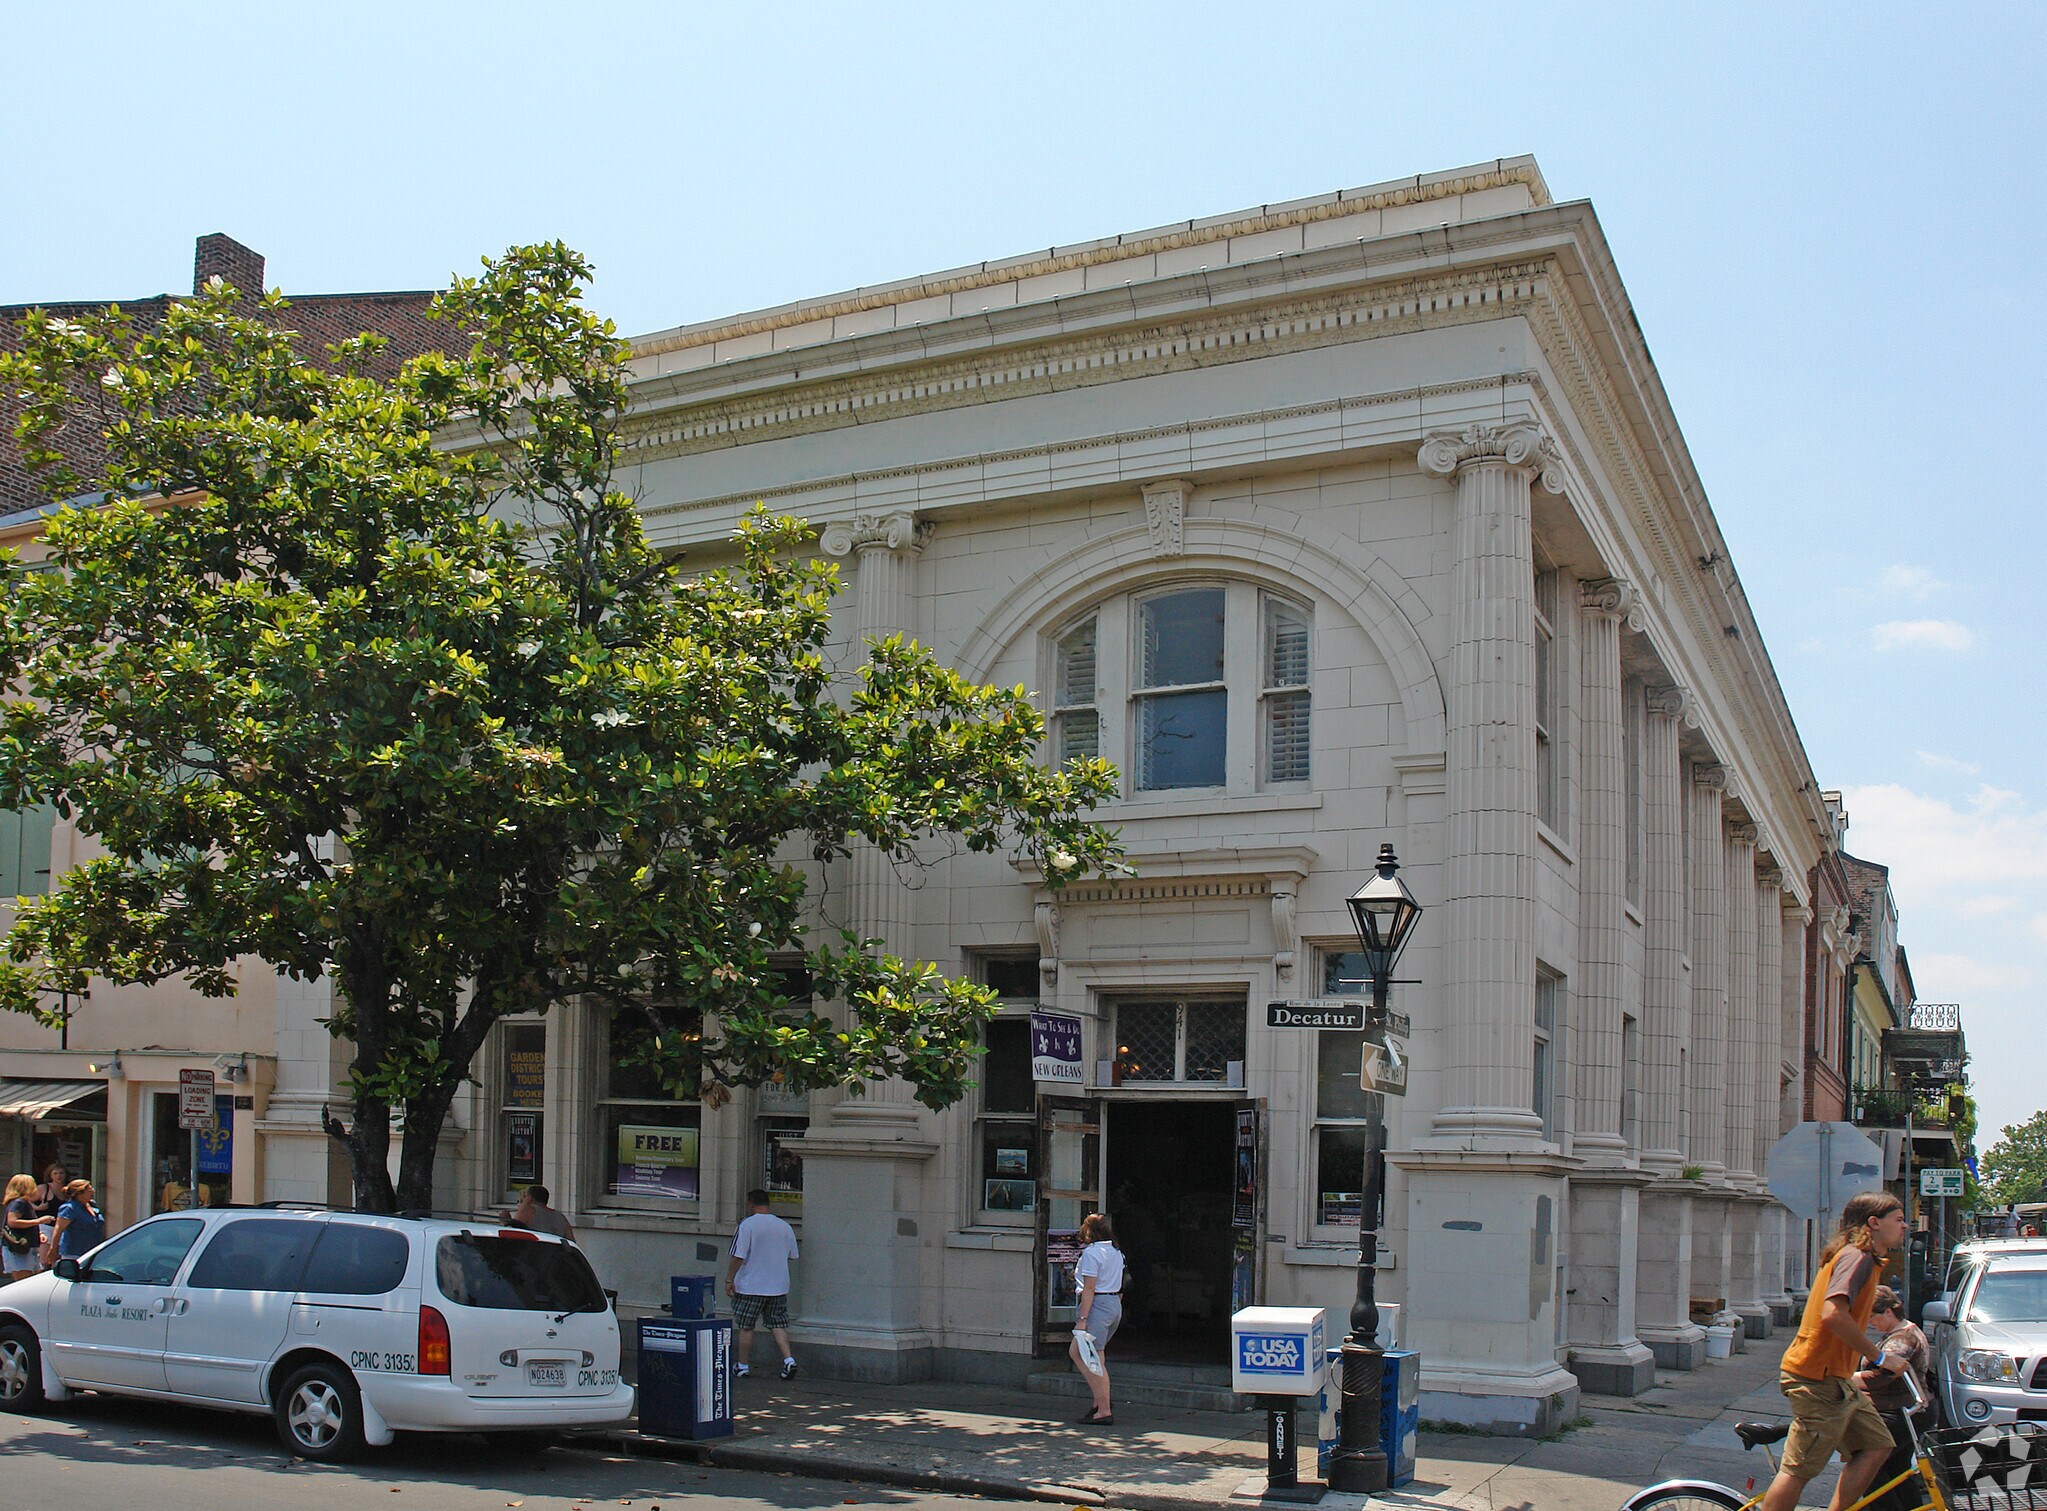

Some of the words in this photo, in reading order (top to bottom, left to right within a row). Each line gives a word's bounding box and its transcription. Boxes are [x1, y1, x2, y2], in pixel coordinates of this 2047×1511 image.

[1273, 1009, 1356, 1026] Decatur
[181, 1071, 191, 1081] NO
[191, 1073, 212, 1081] PARKING
[1034, 1063, 1050, 1076] NEW
[1052, 1064, 1082, 1079] ORLEANS
[1377, 1061, 1389, 1080] ONE
[516, 1075, 543, 1085] TOURS
[184, 1087, 211, 1095] LOADING
[513, 1089, 544, 1098] BOOKE
[635, 1134, 682, 1152] FREE
[780, 1181, 791, 1190] IN
[81, 1305, 102, 1318] PLAZA
[121, 1309, 148, 1321] RESORT
[1261, 1339, 1298, 1354] USA
[351, 1350, 379, 1369] CPNC
[1243, 1352, 1300, 1367] TODAY
[531, 1369, 564, 1380] N024638
[578, 1371, 599, 1387] CPNC
[715, 1402, 723, 1420] The
[1275, 1416, 1285, 1460] GANNETT
